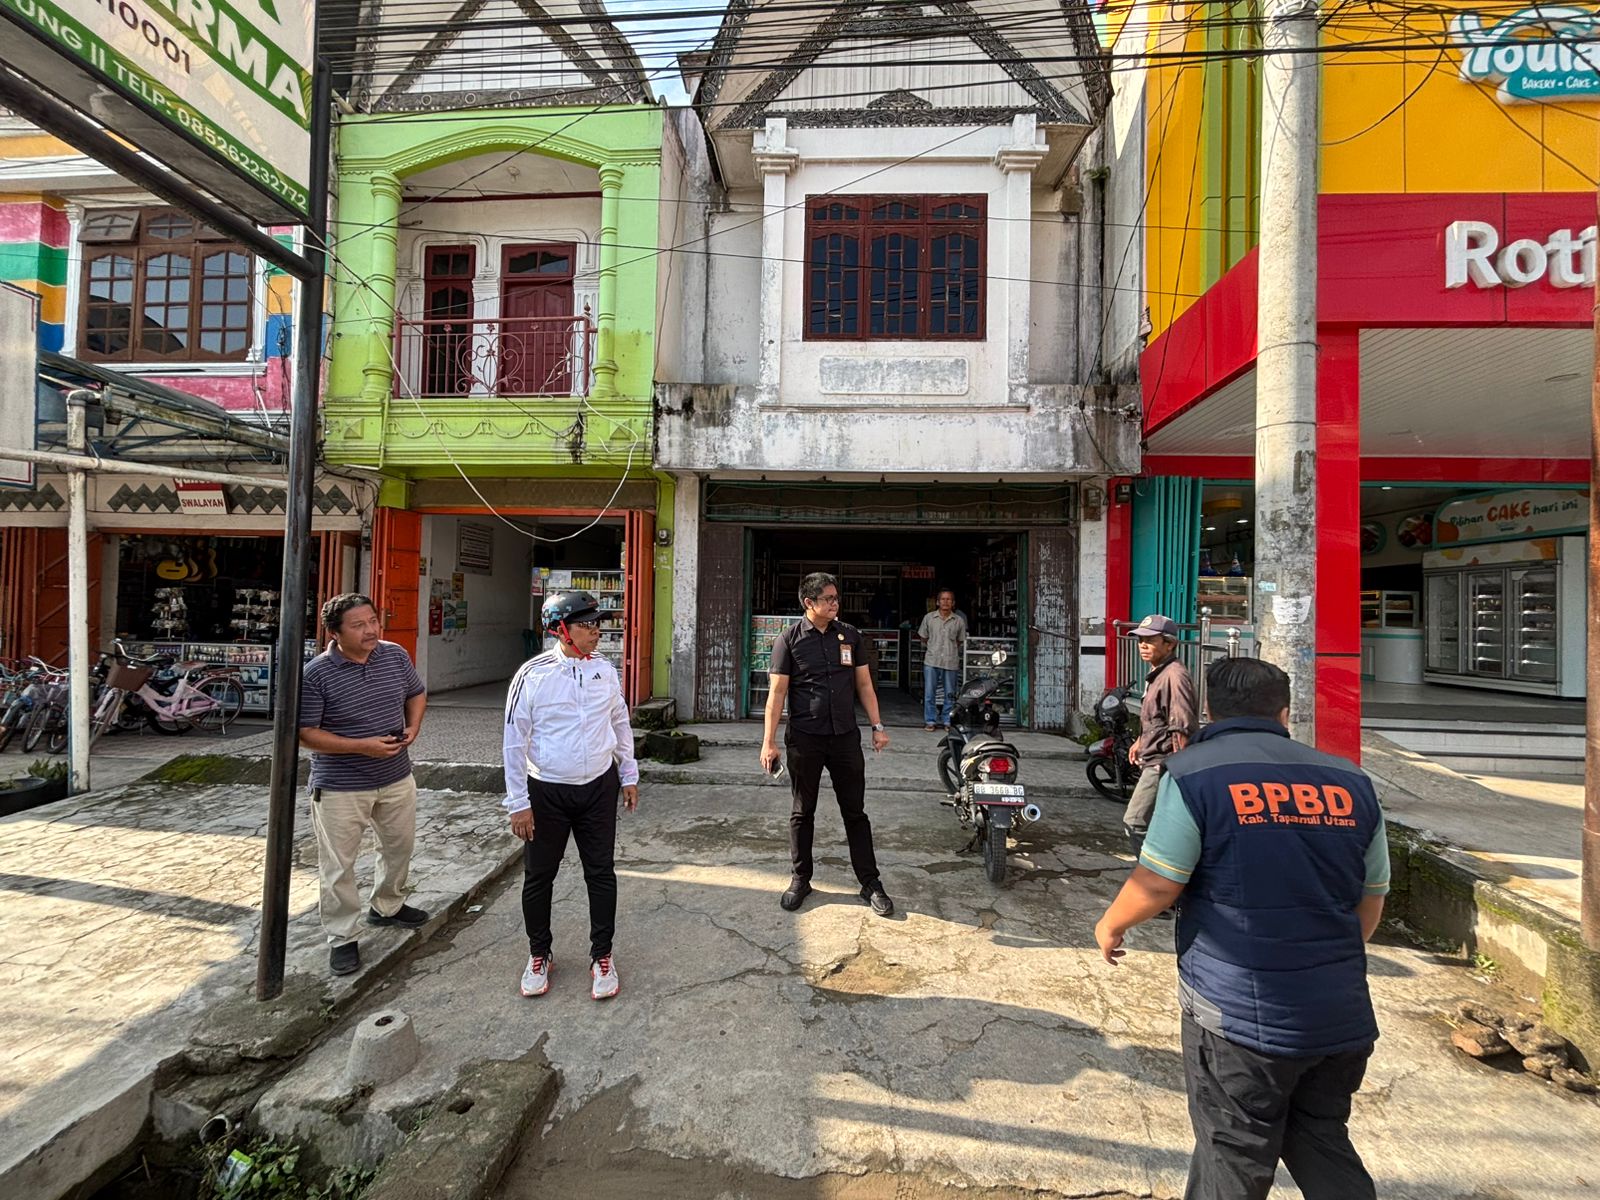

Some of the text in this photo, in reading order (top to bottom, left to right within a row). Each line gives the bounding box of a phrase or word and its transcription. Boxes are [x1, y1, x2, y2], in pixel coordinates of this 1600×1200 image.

[158, 0, 307, 121] RMA
[1521, 75, 1591, 90] BAKERY CAKE
[15, 0, 83, 49] UNG
[113, 60, 172, 115] TELP:
[177, 107, 307, 210] 085262232772
[181, 498, 225, 508] SWALAYAN
[1486, 501, 1531, 522] CAKE
[1533, 502, 1559, 515] hari
[1562, 499, 1578, 510] ini
[1228, 782, 1353, 816] BPBD
[1238, 814, 1356, 827] Kab. Tapanuli Utara
